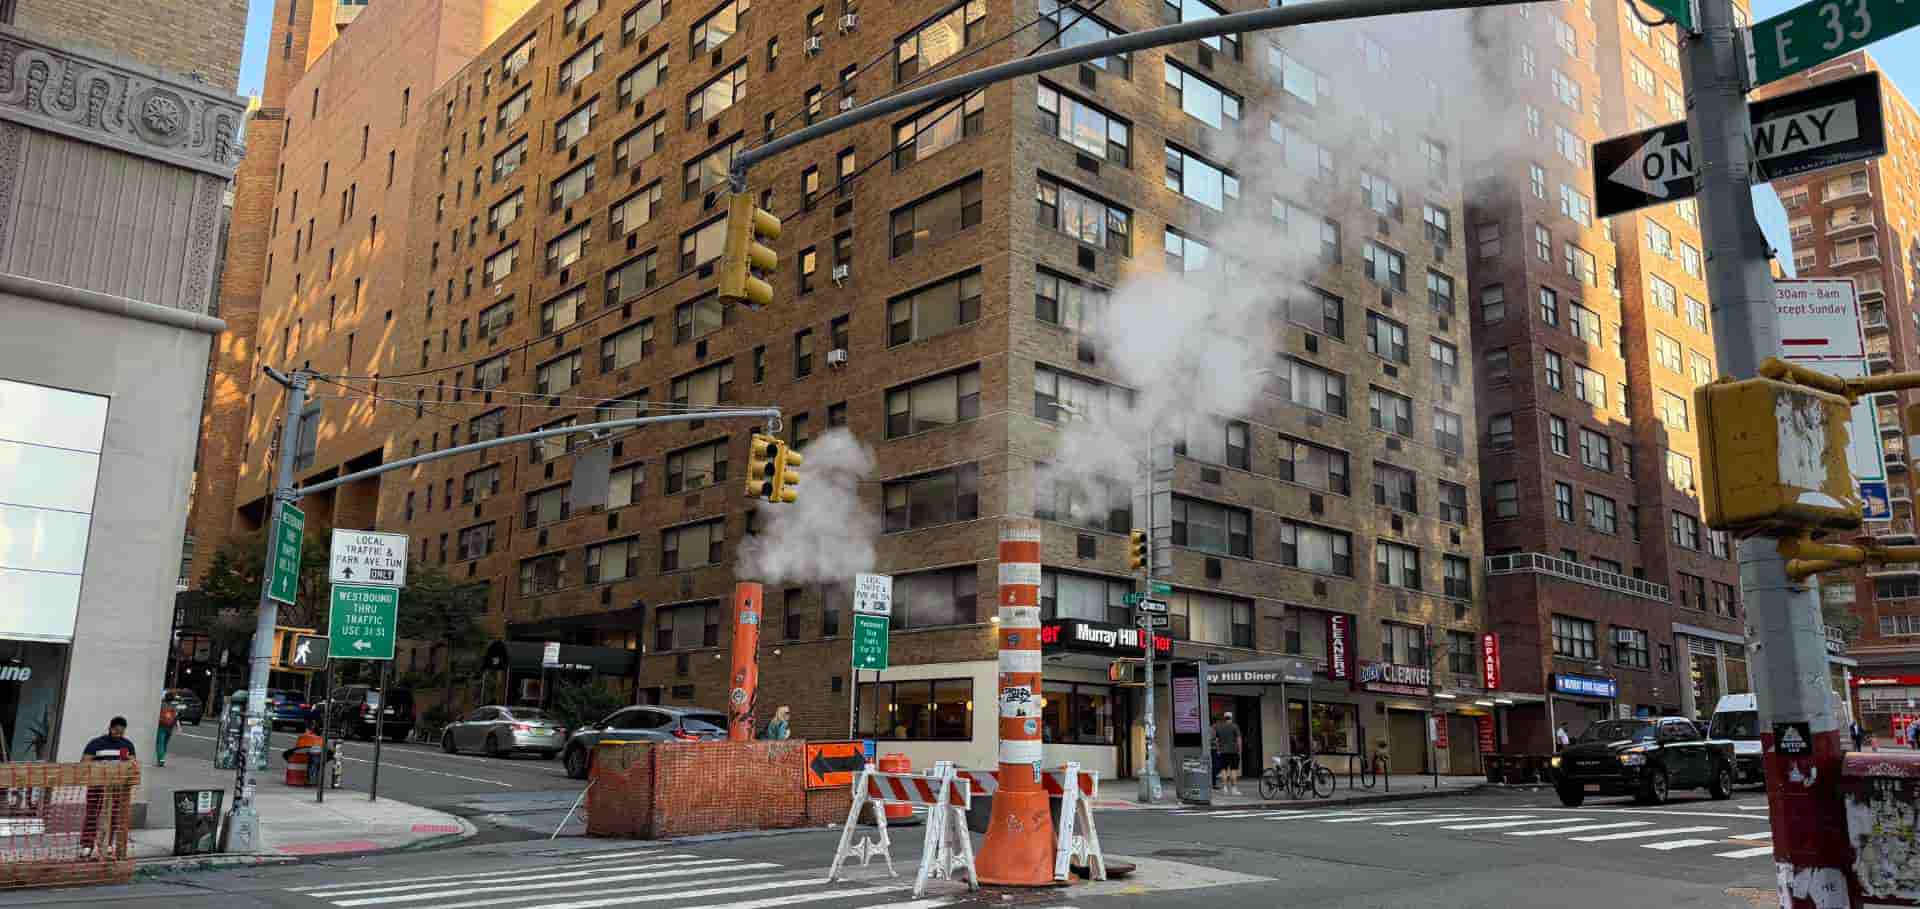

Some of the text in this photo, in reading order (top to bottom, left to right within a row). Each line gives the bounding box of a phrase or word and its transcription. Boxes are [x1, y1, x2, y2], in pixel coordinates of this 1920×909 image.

[1775, 0, 1872, 69] E 33
[1642, 108, 1836, 181] ON WAY
[1817, 288, 1840, 299] 8am
[1776, 303, 1846, 315] xcept Sunday
[356, 535, 384, 546] LOCAL
[345, 545, 393, 557] TRAFFIC &
[335, 555, 401, 569] PARK AVE TUN
[370, 569, 394, 581] ONLY
[339, 592, 393, 604] WESTBOUND
[353, 603, 378, 613] THRU
[345, 614, 383, 625] TRAFFIC
[342, 626, 360, 637] USE
[1076, 623, 1117, 648] Murray
[1118, 628, 1138, 647] Hill
[1332, 615, 1345, 678] CLEANERS
[1486, 647, 1496, 689] PARK
[1206, 673, 1219, 682] ay
[1221, 671, 1242, 681] Hill
[1244, 671, 1279, 681] Diner
